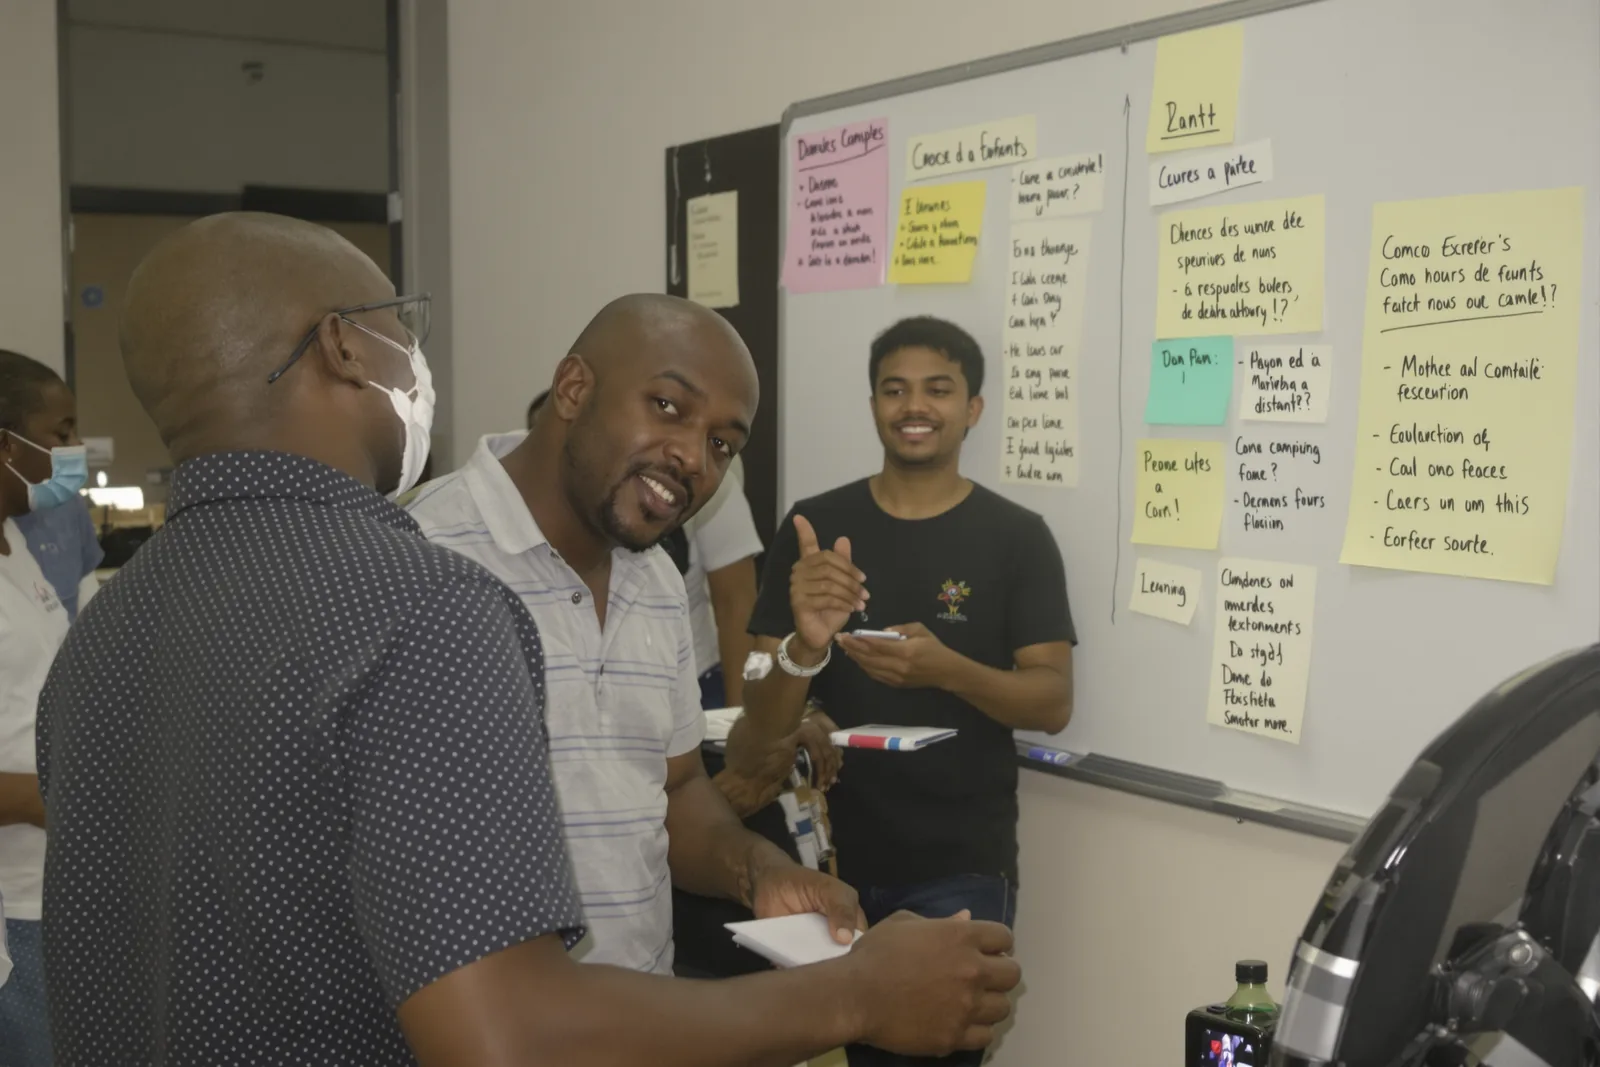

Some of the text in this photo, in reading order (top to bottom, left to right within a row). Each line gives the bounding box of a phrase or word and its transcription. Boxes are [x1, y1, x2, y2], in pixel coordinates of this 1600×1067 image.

[1208, 167, 1216, 180] a
[1234, 244, 1246, 262] de
[1425, 267, 1465, 283] hours
[1474, 263, 1490, 282] de
